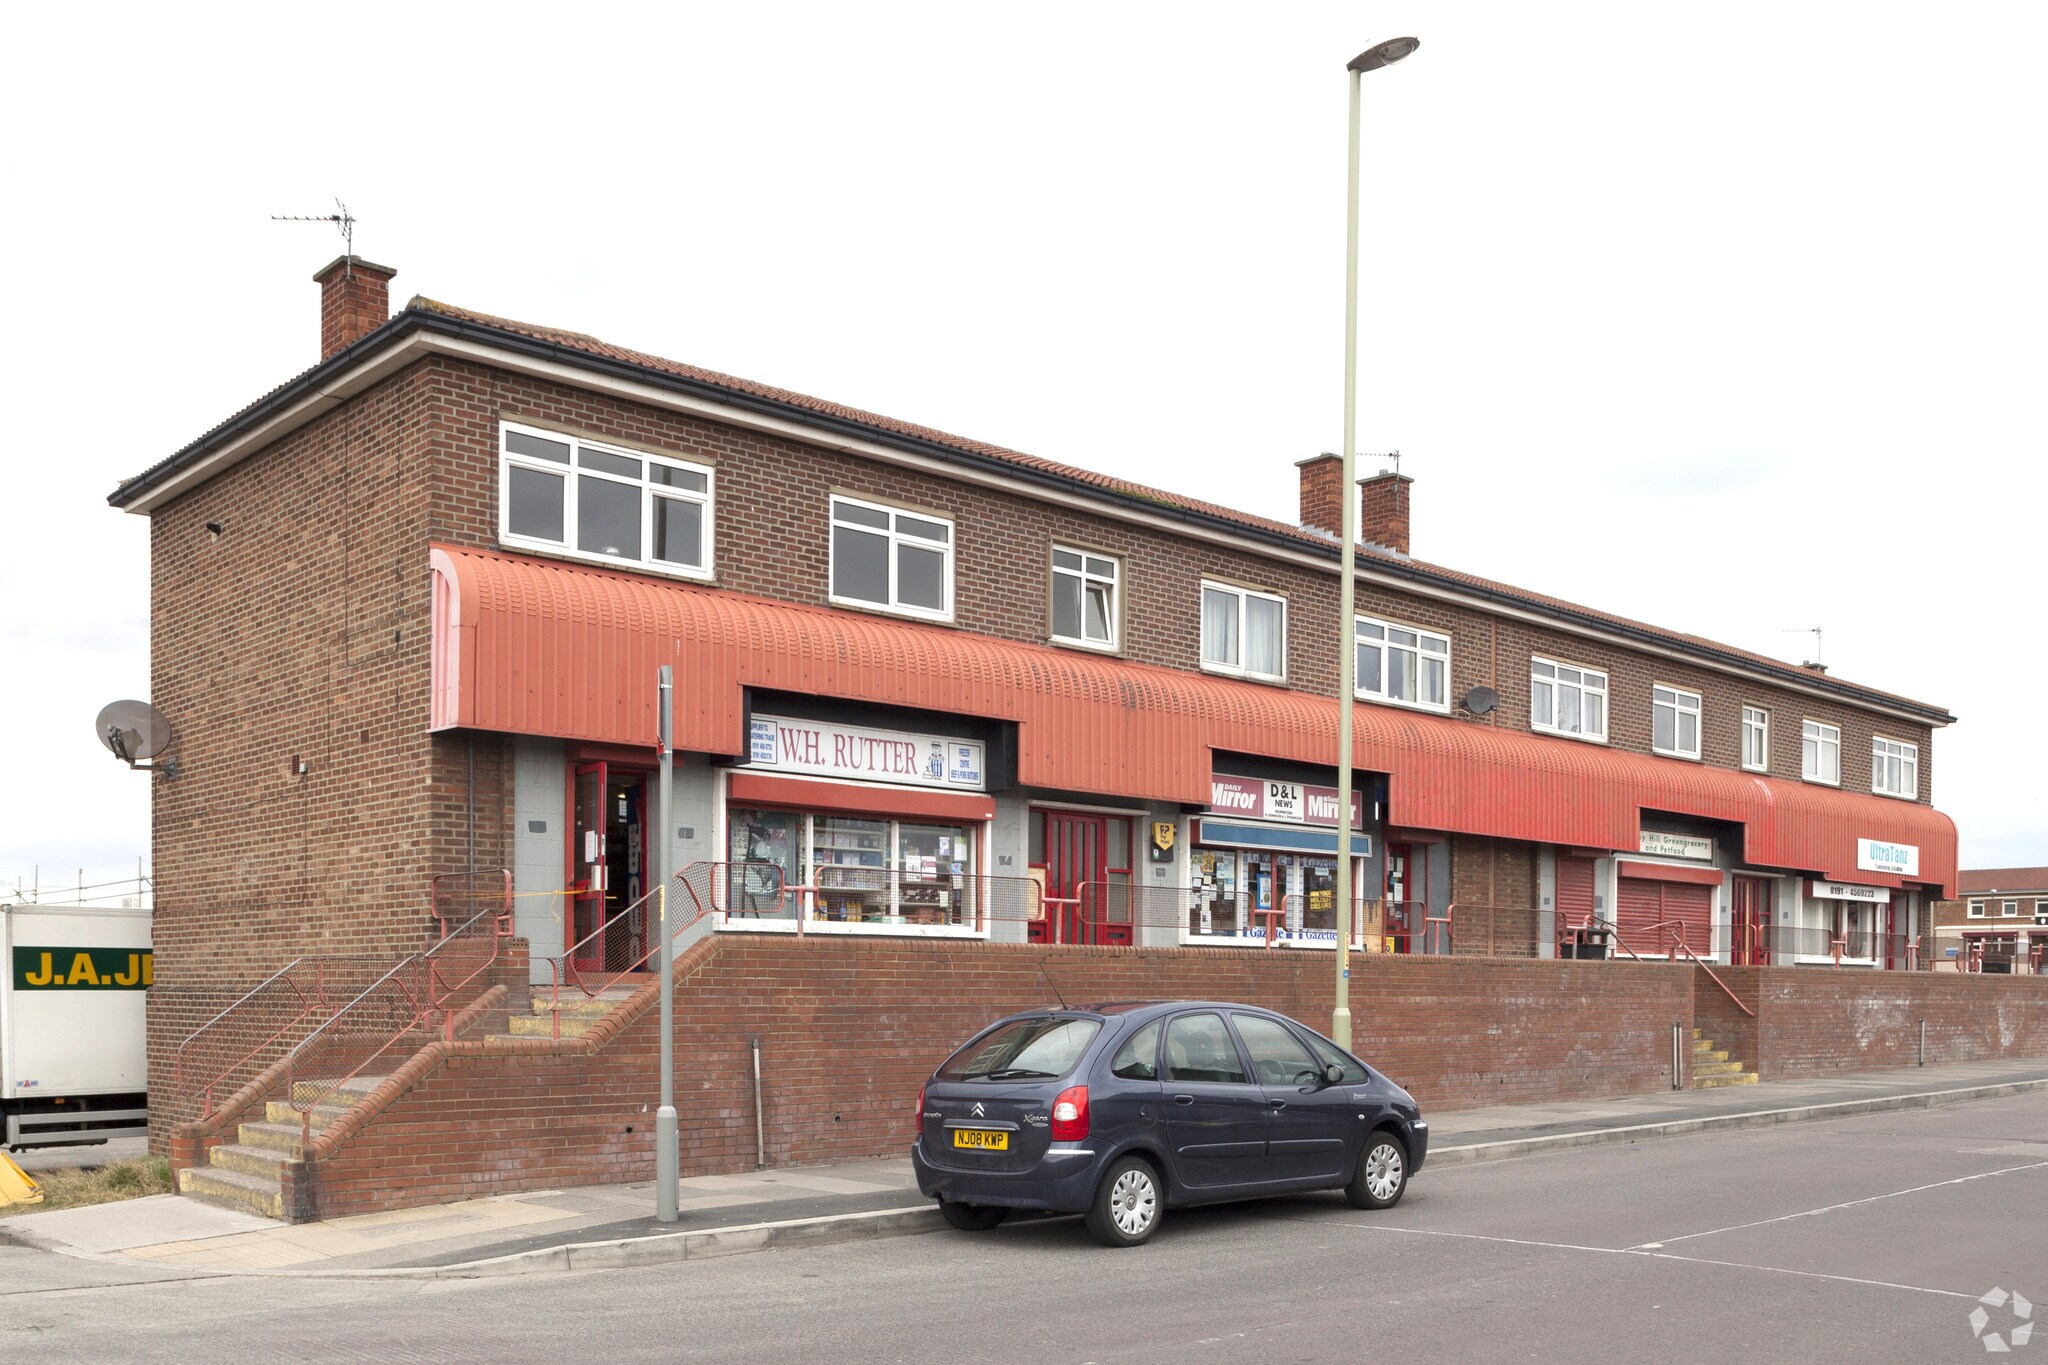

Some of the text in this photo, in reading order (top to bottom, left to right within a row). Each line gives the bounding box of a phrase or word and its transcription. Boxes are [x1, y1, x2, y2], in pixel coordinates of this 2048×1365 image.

[779, 727, 919, 775] W.H. RUTTER
[1224, 783, 1242, 791] DAILY
[1271, 783, 1297, 800] D & L
[1211, 782, 1257, 810] Mirror
[1274, 799, 1293, 809] NEWS
[1308, 794, 1357, 821] Mirrr
[1648, 834, 1661, 843] Hill
[1663, 836, 1708, 850] Greengrocery
[1660, 845, 1685, 855] Petfood
[1869, 843, 1909, 864] UltraTanz
[1829, 886, 1844, 896] 0191
[957, 1132, 1004, 1147] NJ08 KWP
